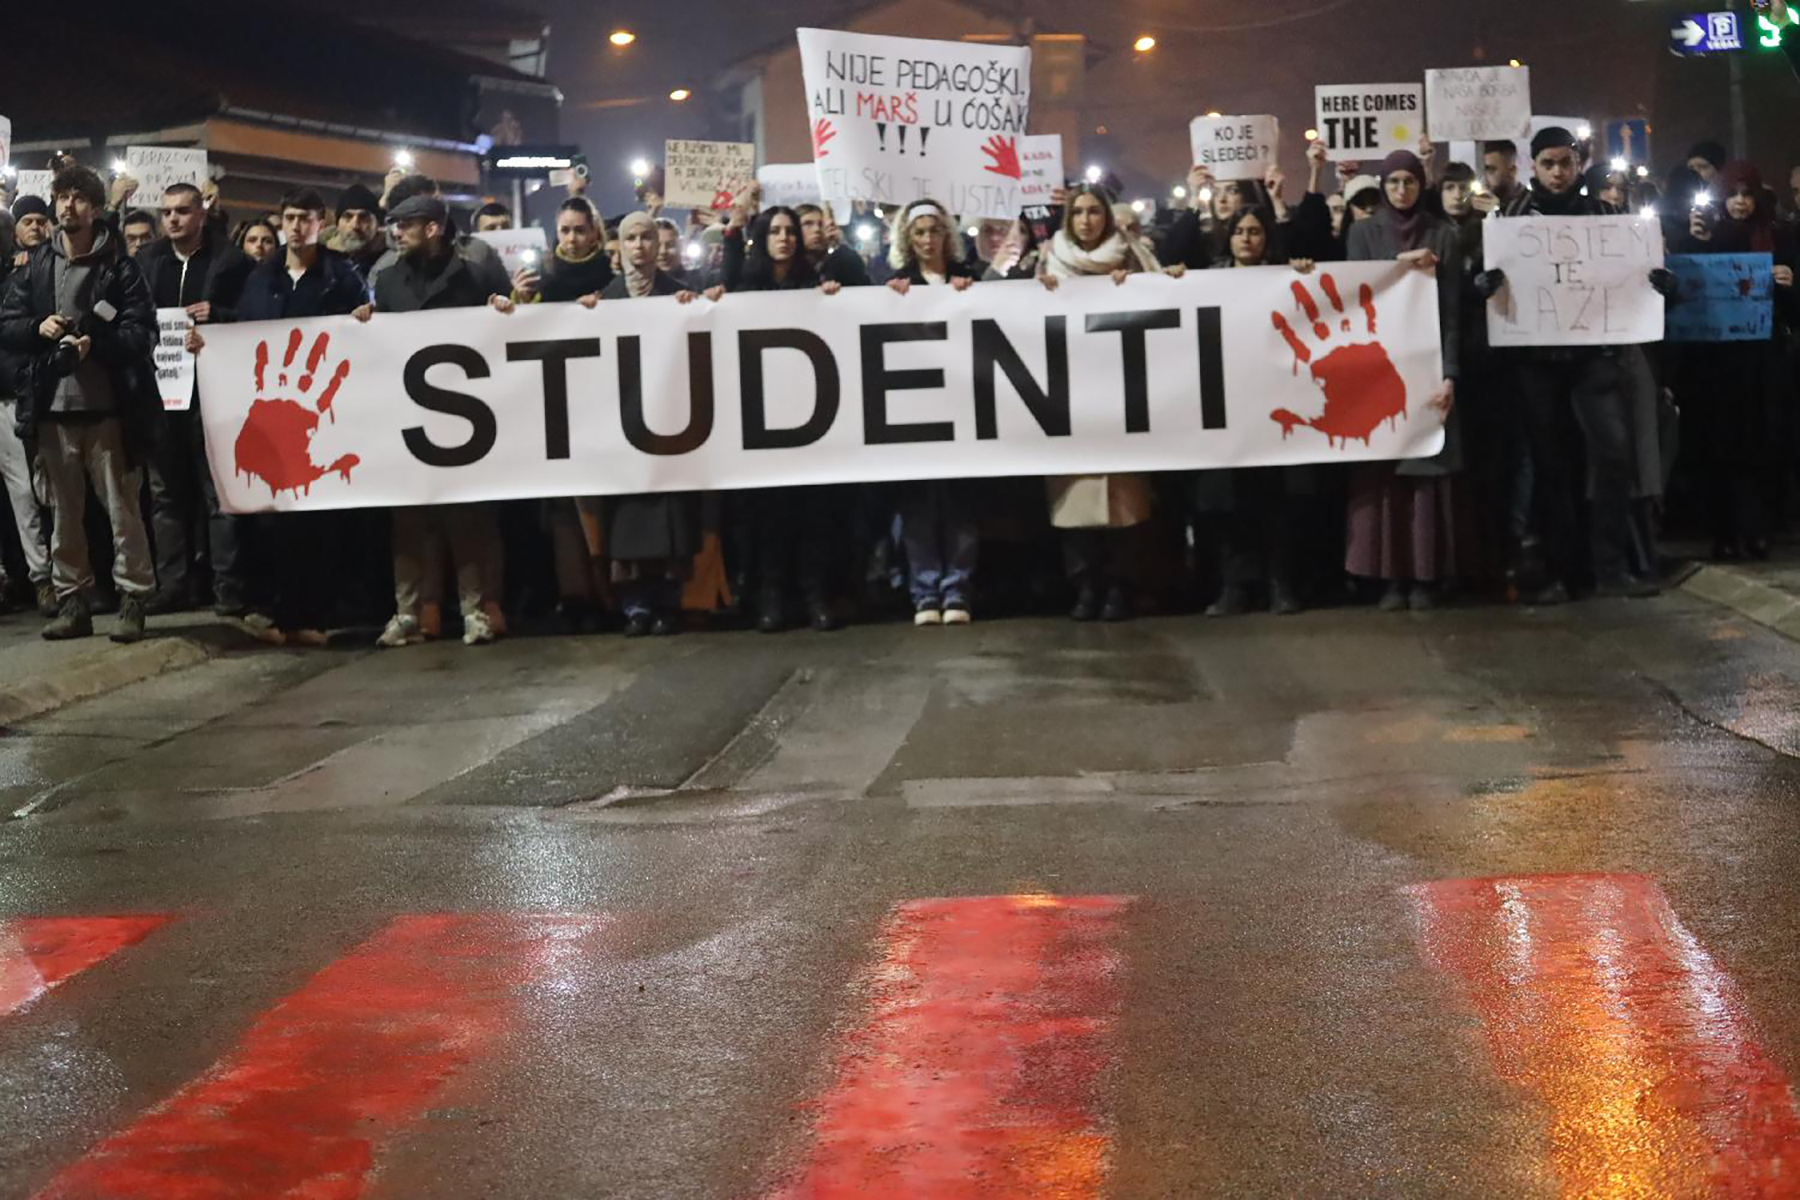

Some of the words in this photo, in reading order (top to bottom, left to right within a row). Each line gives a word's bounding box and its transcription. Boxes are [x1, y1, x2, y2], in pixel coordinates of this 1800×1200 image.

[826, 50, 885, 86] NIJE
[815, 87, 845, 115] ALI
[856, 91, 919, 125] MARŠ
[935, 99, 952, 127] U
[1321, 96, 1359, 112] HERE
[1363, 94, 1416, 111] COMES
[1214, 126, 1234, 142] KO
[1238, 124, 1254, 140] JE
[1324, 117, 1379, 149] THE
[1549, 259, 1584, 284] TE
[400, 304, 1227, 468] STUDENTI
